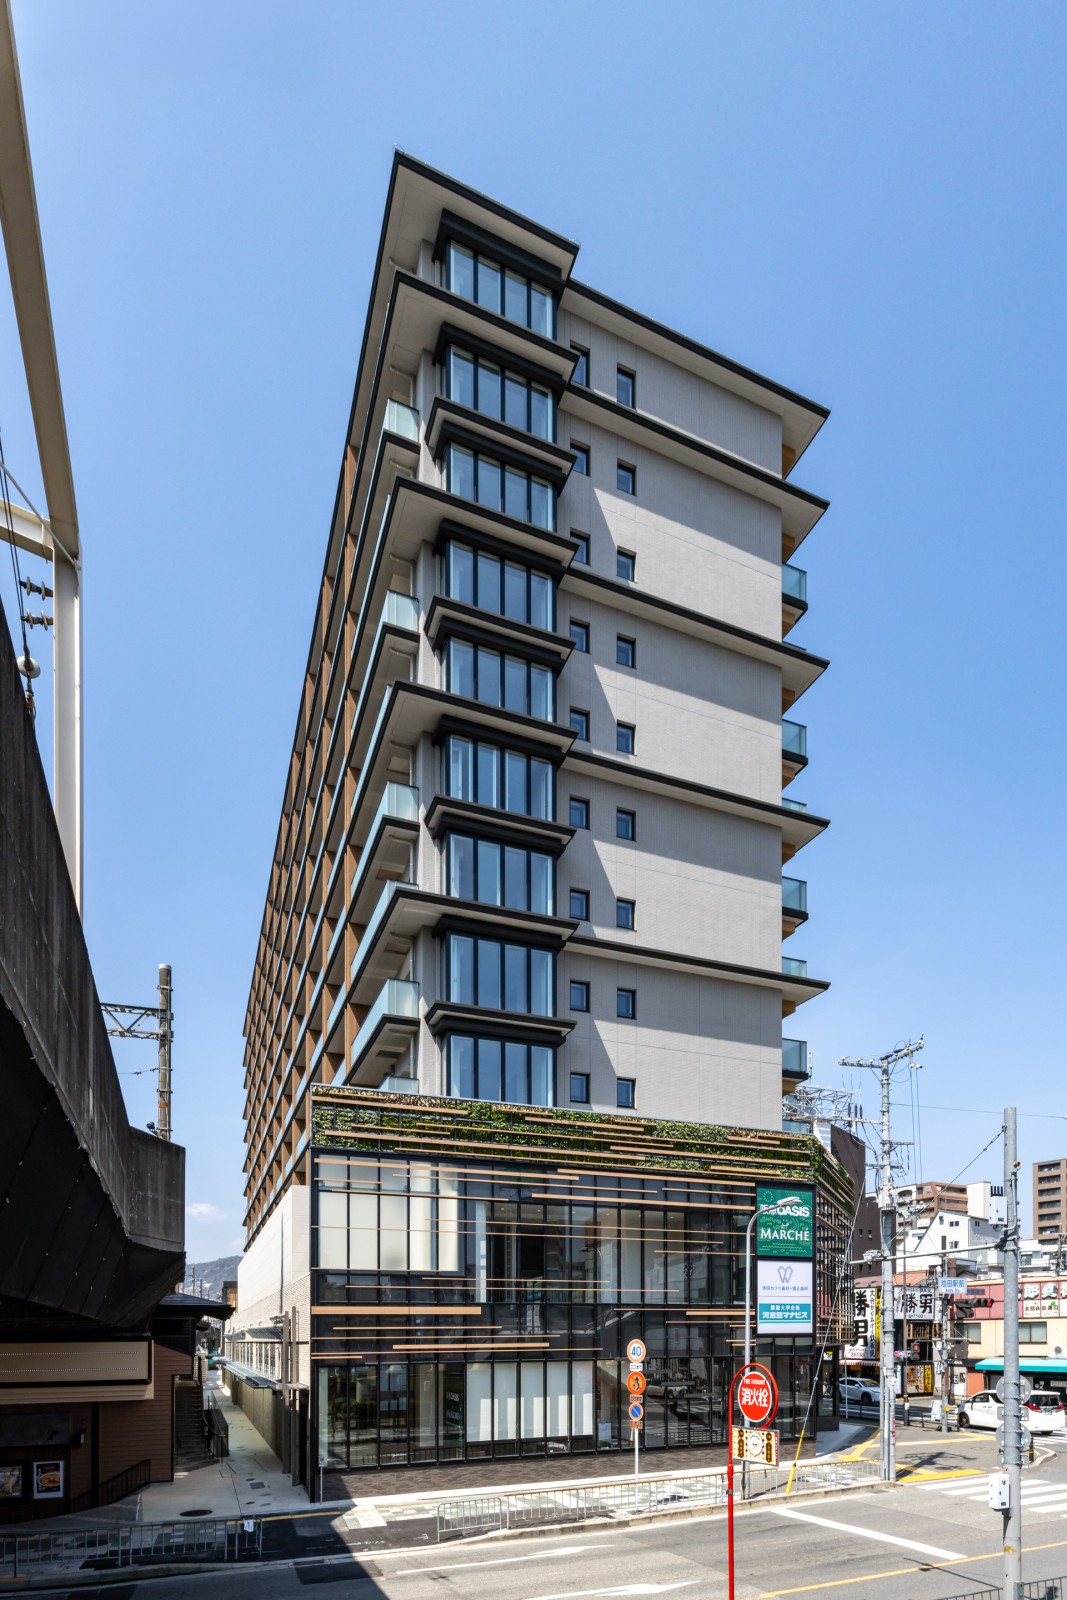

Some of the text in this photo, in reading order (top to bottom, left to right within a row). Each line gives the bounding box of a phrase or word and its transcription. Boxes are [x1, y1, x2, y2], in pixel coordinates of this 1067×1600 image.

[760, 1227, 810, 1241] MARCHÉ
[900, 1293, 933, 1314] 勝男
[631, 1346, 642, 1357] 40
[741, 1387, 769, 1407] 消火栓
